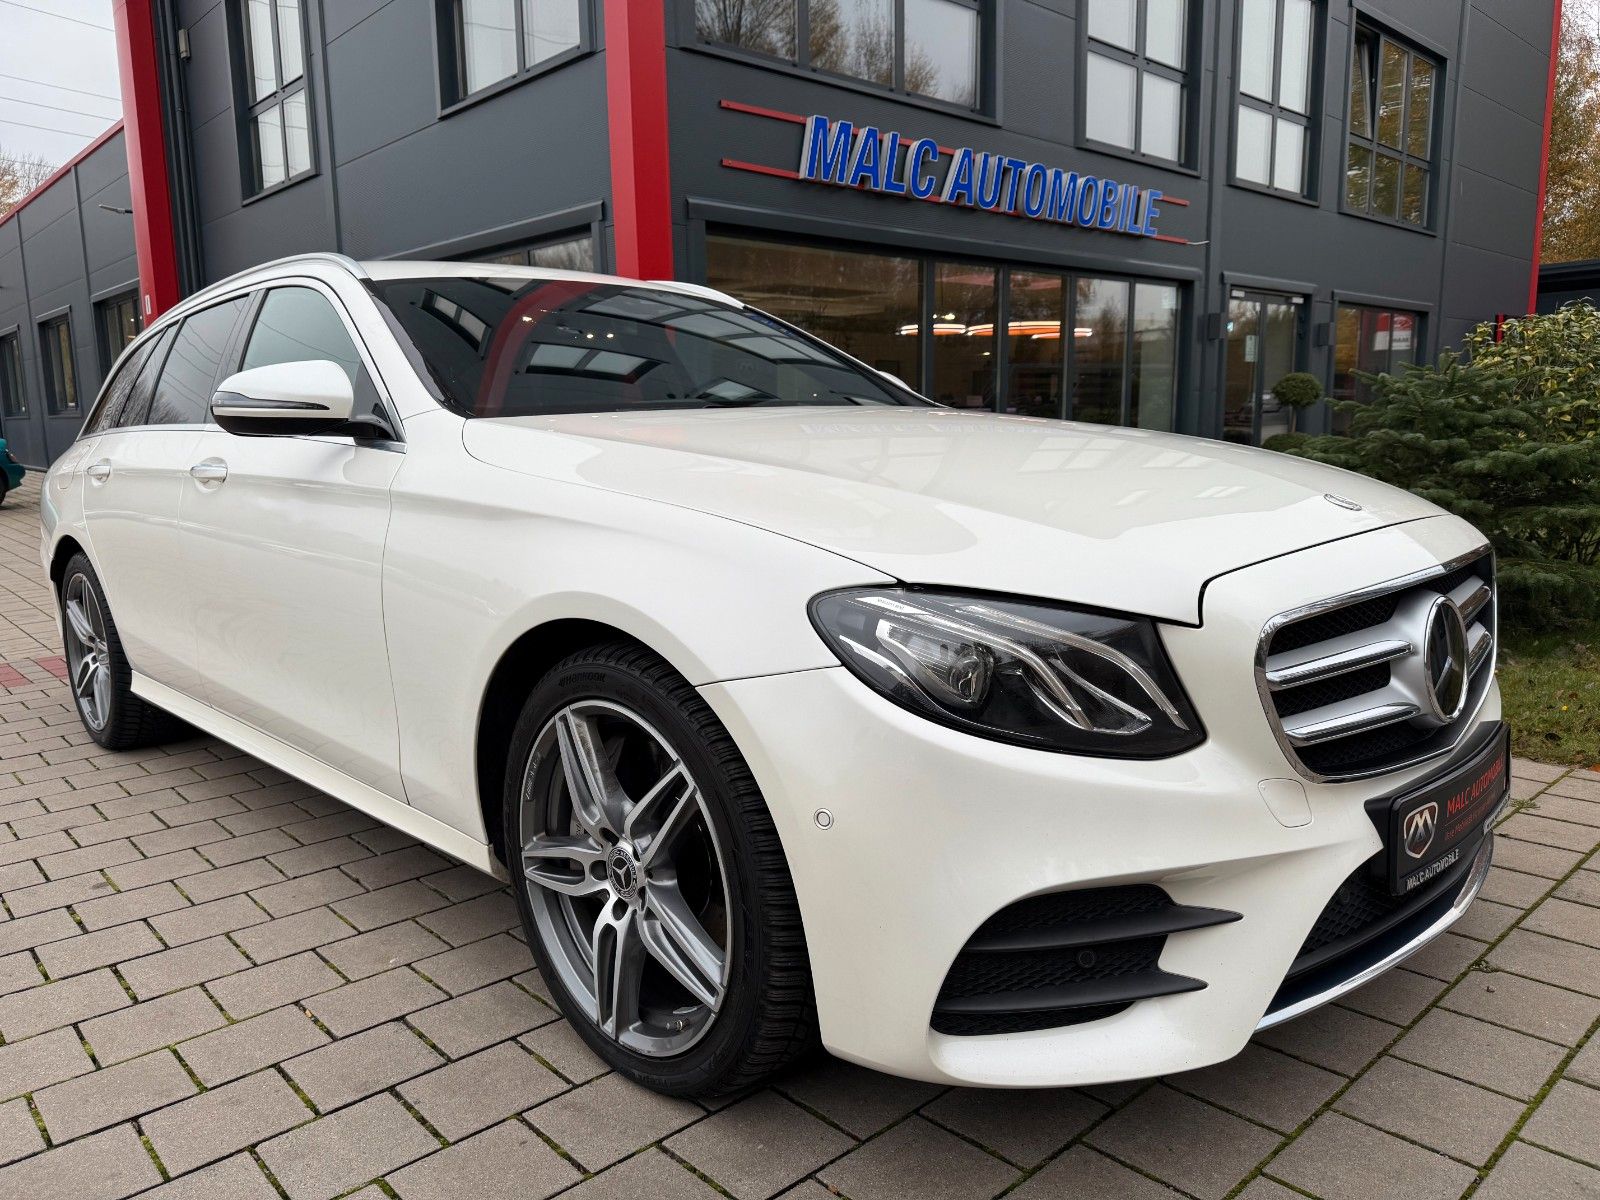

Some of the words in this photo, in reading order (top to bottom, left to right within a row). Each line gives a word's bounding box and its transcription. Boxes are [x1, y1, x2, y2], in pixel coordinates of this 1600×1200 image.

[801, 115, 939, 199] MALC
[941, 147, 1163, 236] AUTOMOBILE
[1447, 787, 1471, 817] MALC
